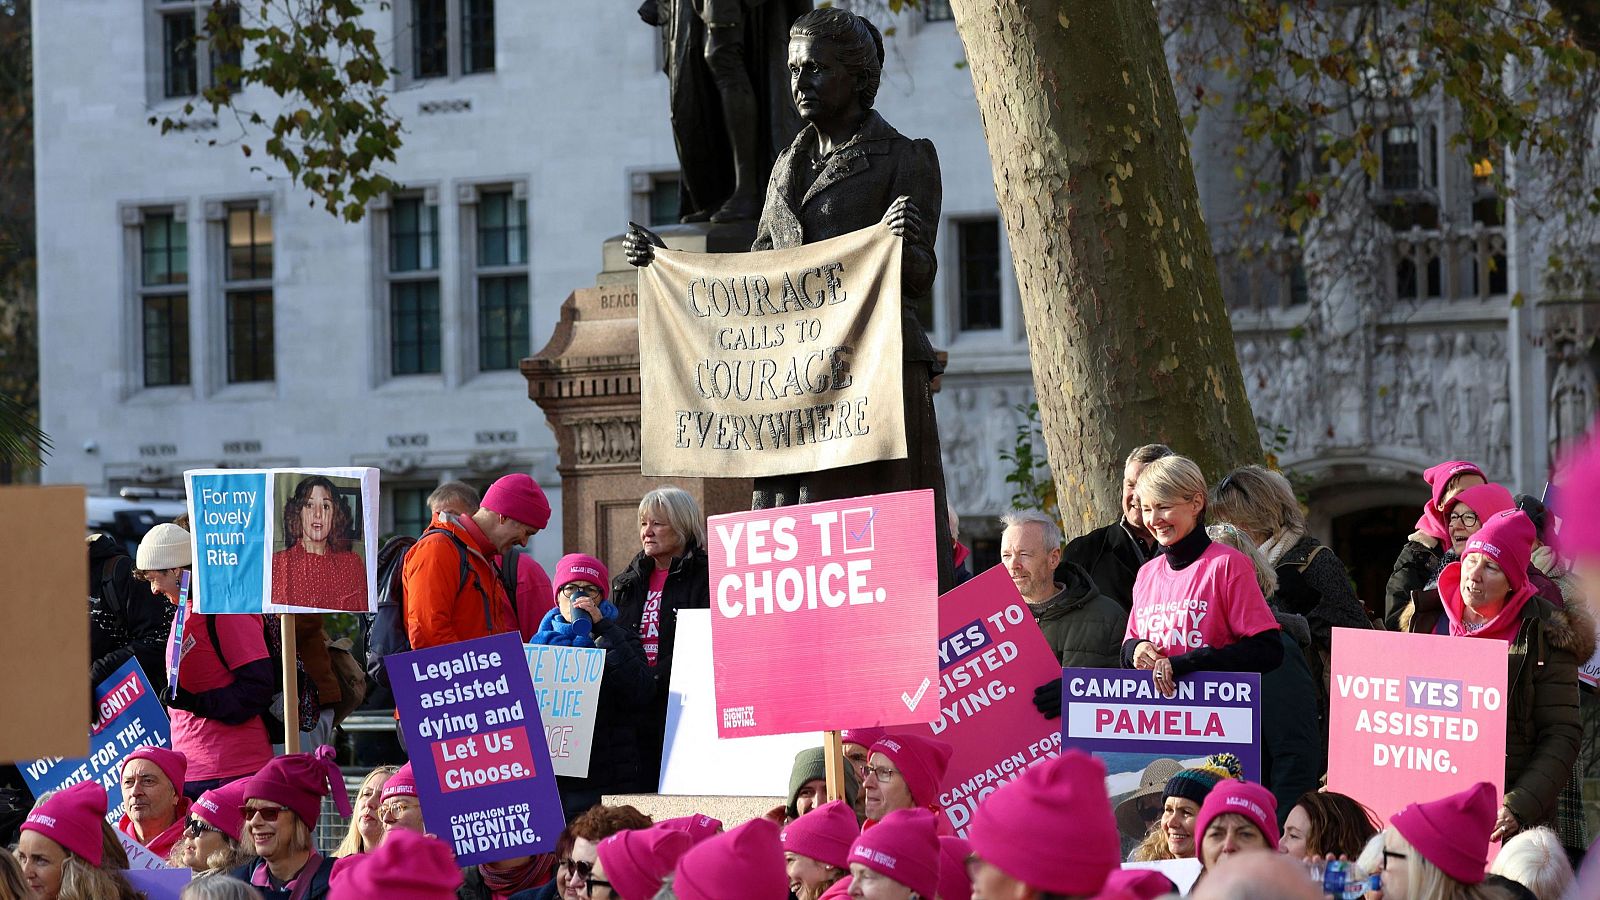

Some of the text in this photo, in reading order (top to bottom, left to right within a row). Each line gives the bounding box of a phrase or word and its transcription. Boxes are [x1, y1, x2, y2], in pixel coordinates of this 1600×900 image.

[601, 292, 638, 309] BEACO
[688, 262, 847, 318] COURAGE
[718, 318, 822, 351] CALLS TO
[694, 346, 853, 401] COURAGE
[675, 397, 870, 450] EVERYWHERE
[202, 489, 256, 508] For my
[204, 508, 252, 528] lovely
[205, 531, 245, 545] mum
[714, 517, 798, 567] YES
[206, 549, 238, 565] Rita
[717, 559, 887, 618] CHOICE.
[1183, 599, 1208, 611] FOR
[938, 604, 1024, 664] YES TO
[412, 651, 502, 681] Legalise
[524, 646, 603, 683] TE YES TO
[420, 674, 510, 709] assisted
[1070, 678, 1251, 701] CAMPAN FOR
[1337, 675, 1500, 710] VOTE YES TO
[418, 700, 525, 739] dying and
[724, 711, 754, 721] DIGNITY
[929, 680, 1016, 735] DYING.
[724, 718, 757, 728] IN DYING.
[1095, 709, 1225, 737] PAMELA
[1355, 709, 1478, 741] ASSISTED
[90, 742, 119, 773] FOR
[116, 717, 146, 749] THE
[441, 733, 513, 762] Let Us
[1373, 743, 1457, 774] DYING.
[27, 755, 64, 781] VOT
[445, 762, 530, 789] Choose.
[940, 752, 1026, 806] CAMPAIGN
[1028, 732, 1062, 758] FOR
[450, 803, 529, 824] CAMPAIGN FOR
[452, 812, 530, 840] DIGNITY
[121, 840, 144, 860] MY
[455, 828, 541, 856] IN DYING.
